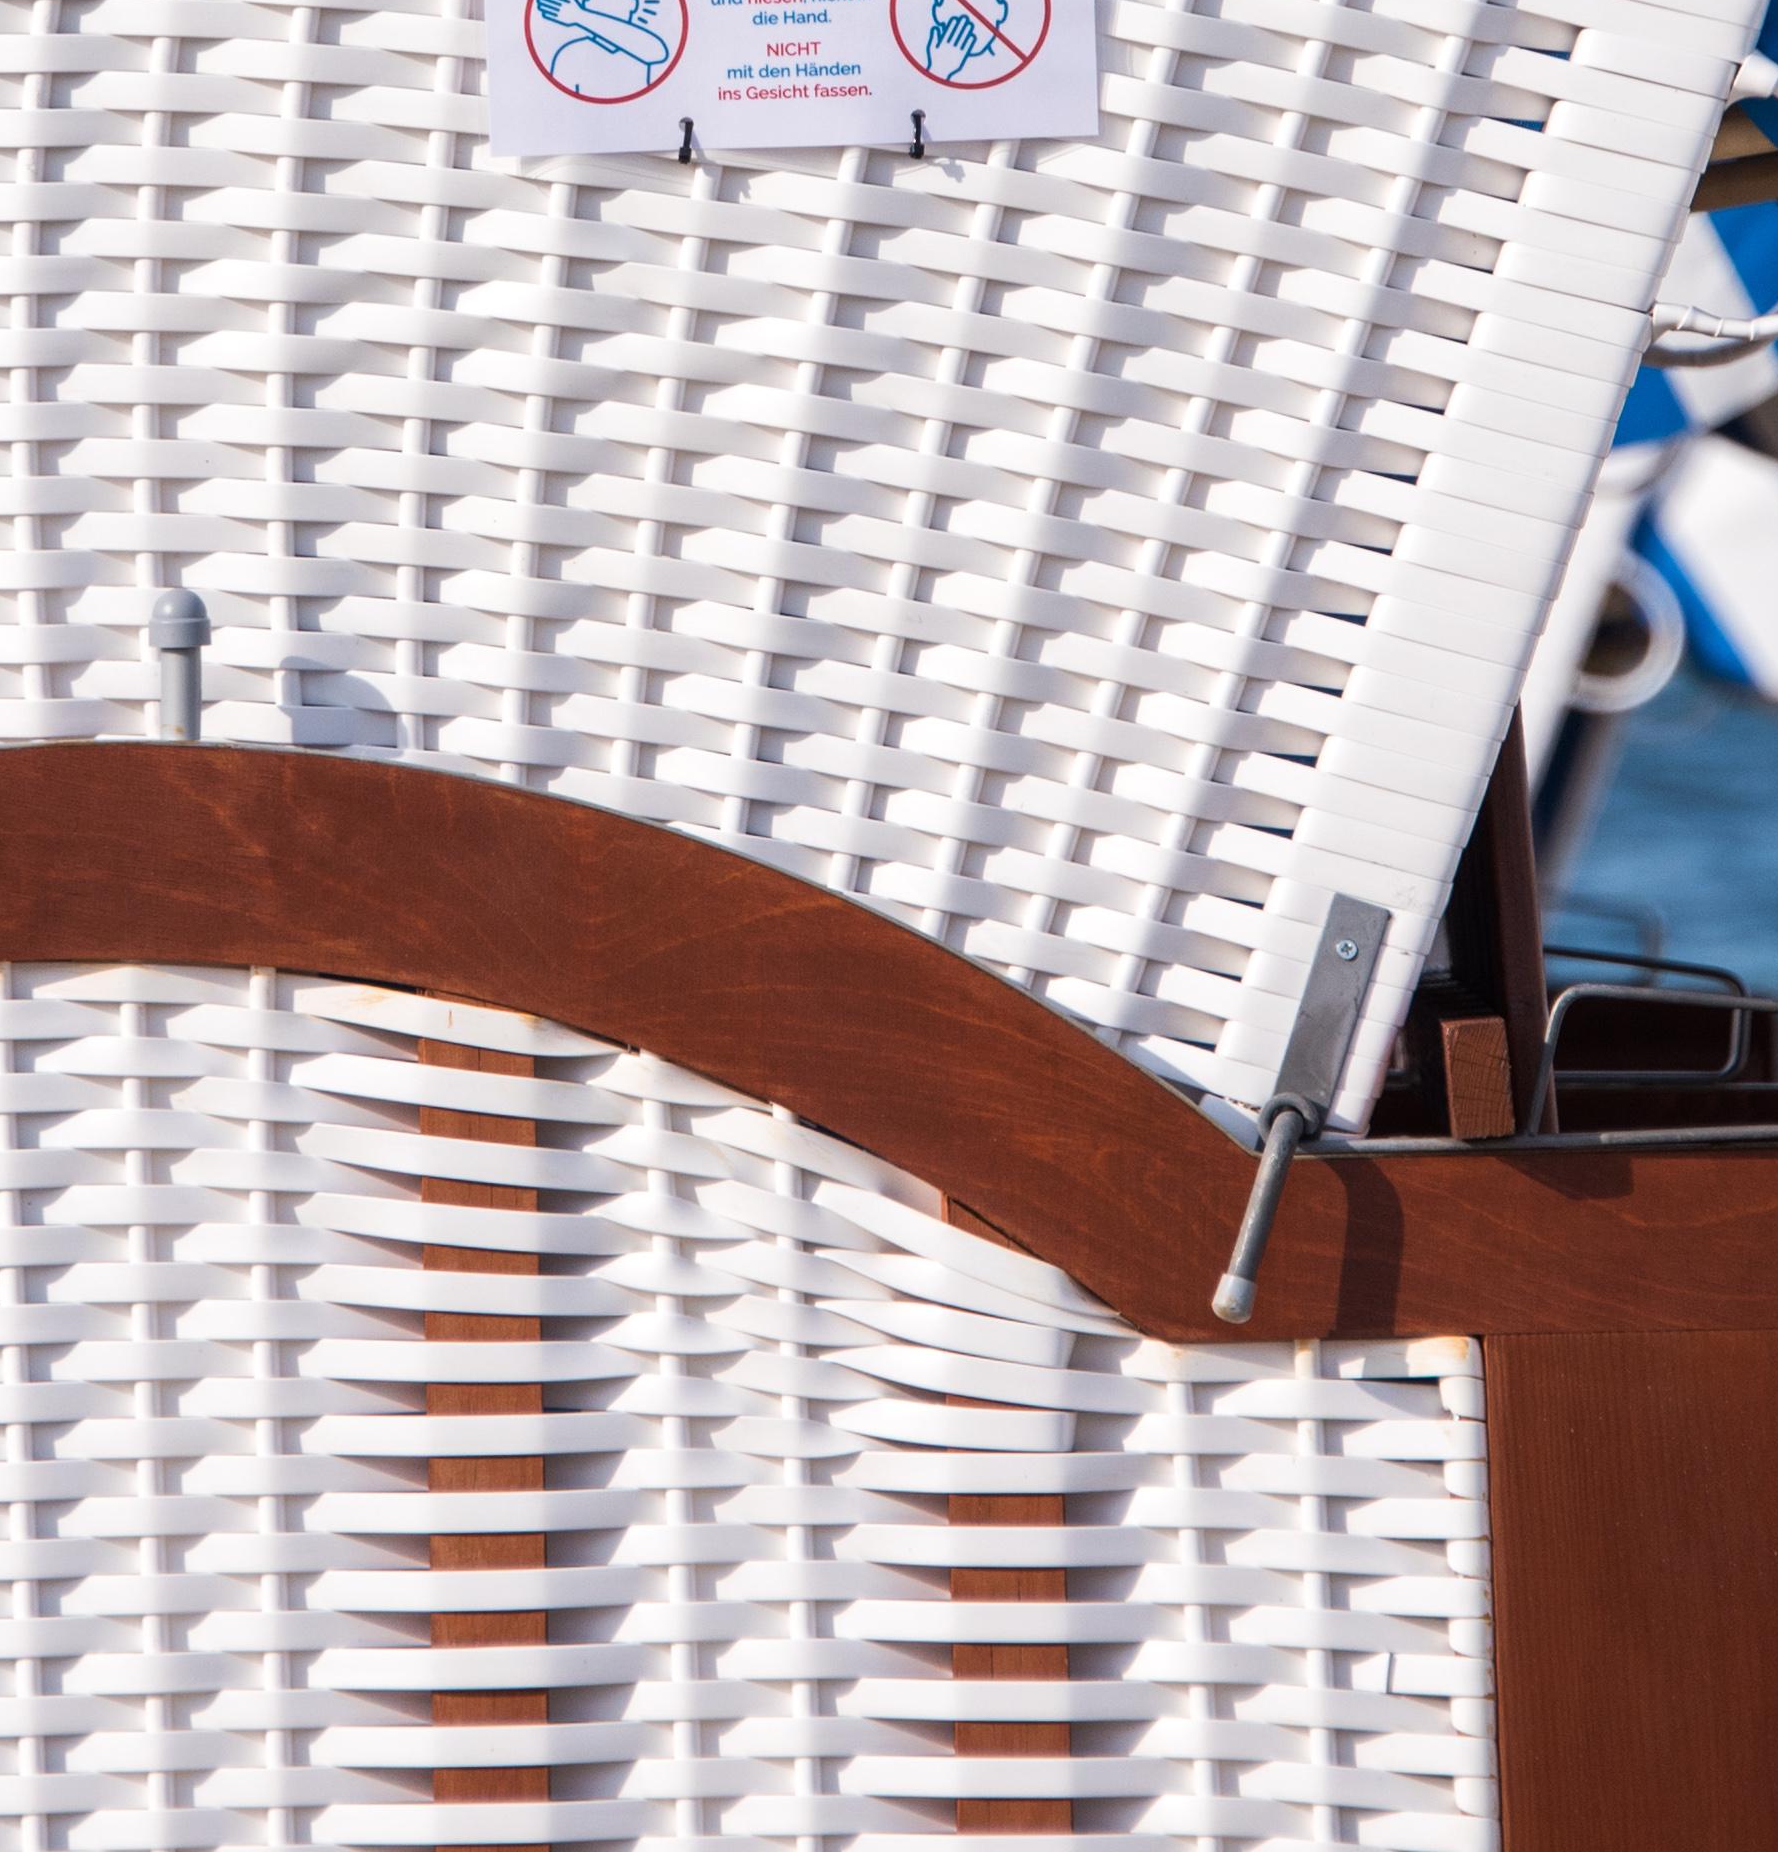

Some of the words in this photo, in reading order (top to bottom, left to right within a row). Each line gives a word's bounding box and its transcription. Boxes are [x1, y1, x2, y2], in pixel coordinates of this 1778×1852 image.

[752, 11, 778, 25] die
[784, 9, 831, 24] Hand.
[766, 41, 821, 57] NICHT
[727, 64, 753, 79] mit
[758, 63, 790, 78] den
[795, 61, 862, 77] Händen
[718, 87, 741, 101] ins
[746, 84, 809, 99] Gesicht
[814, 83, 872, 98] fassen.
